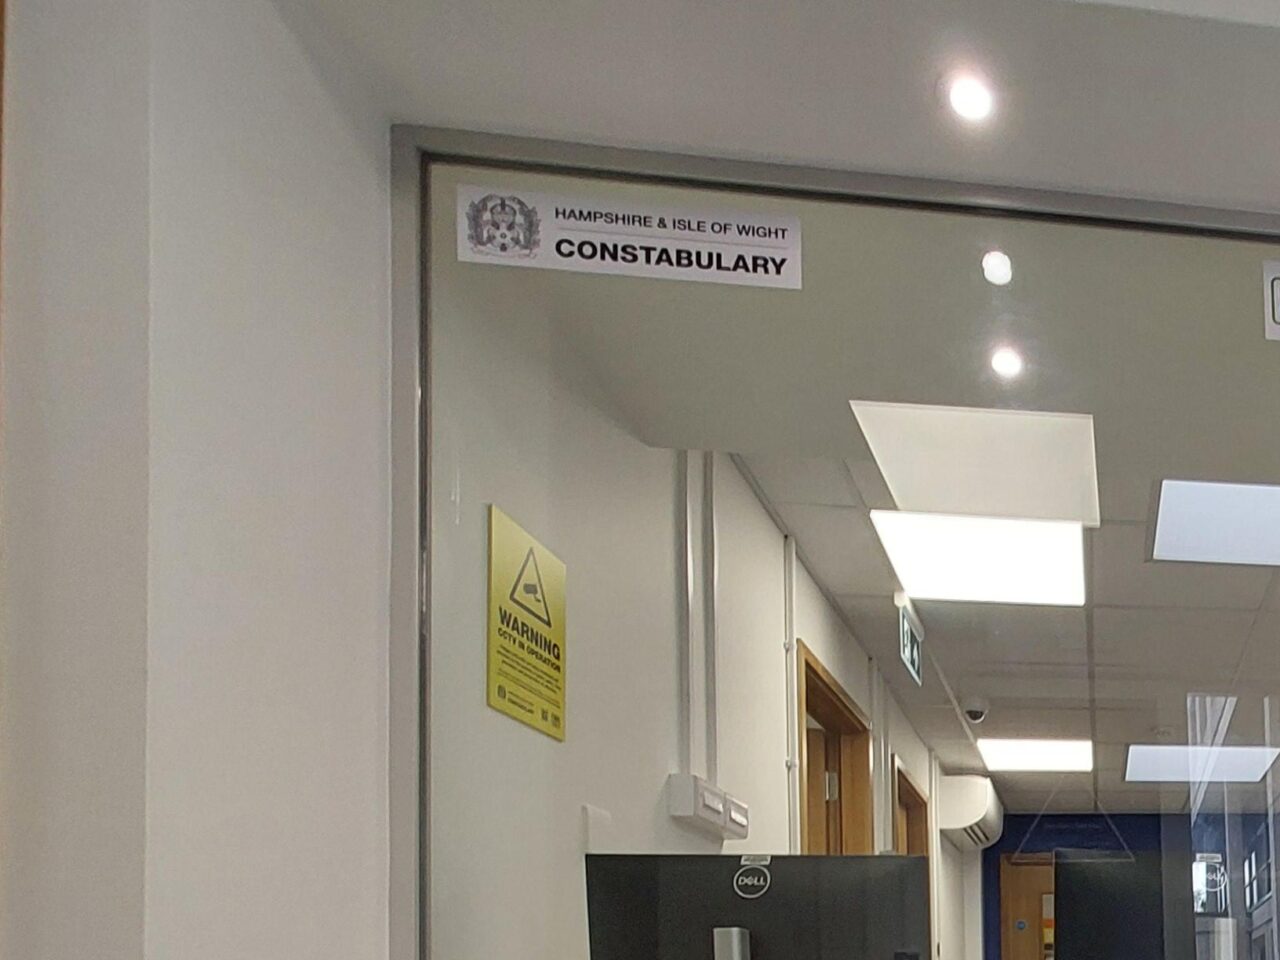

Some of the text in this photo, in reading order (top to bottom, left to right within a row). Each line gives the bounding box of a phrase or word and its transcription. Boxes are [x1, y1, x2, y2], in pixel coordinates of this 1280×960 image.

[555, 207, 788, 240] HAMPSHIRE & ISLE OF WIGHT
[555, 238, 787, 275] CONSTABULARY
[497, 627, 561, 673] CCTV IN OPERATION
[499, 606, 560, 661] WARNING
[738, 876, 765, 885] DELL
